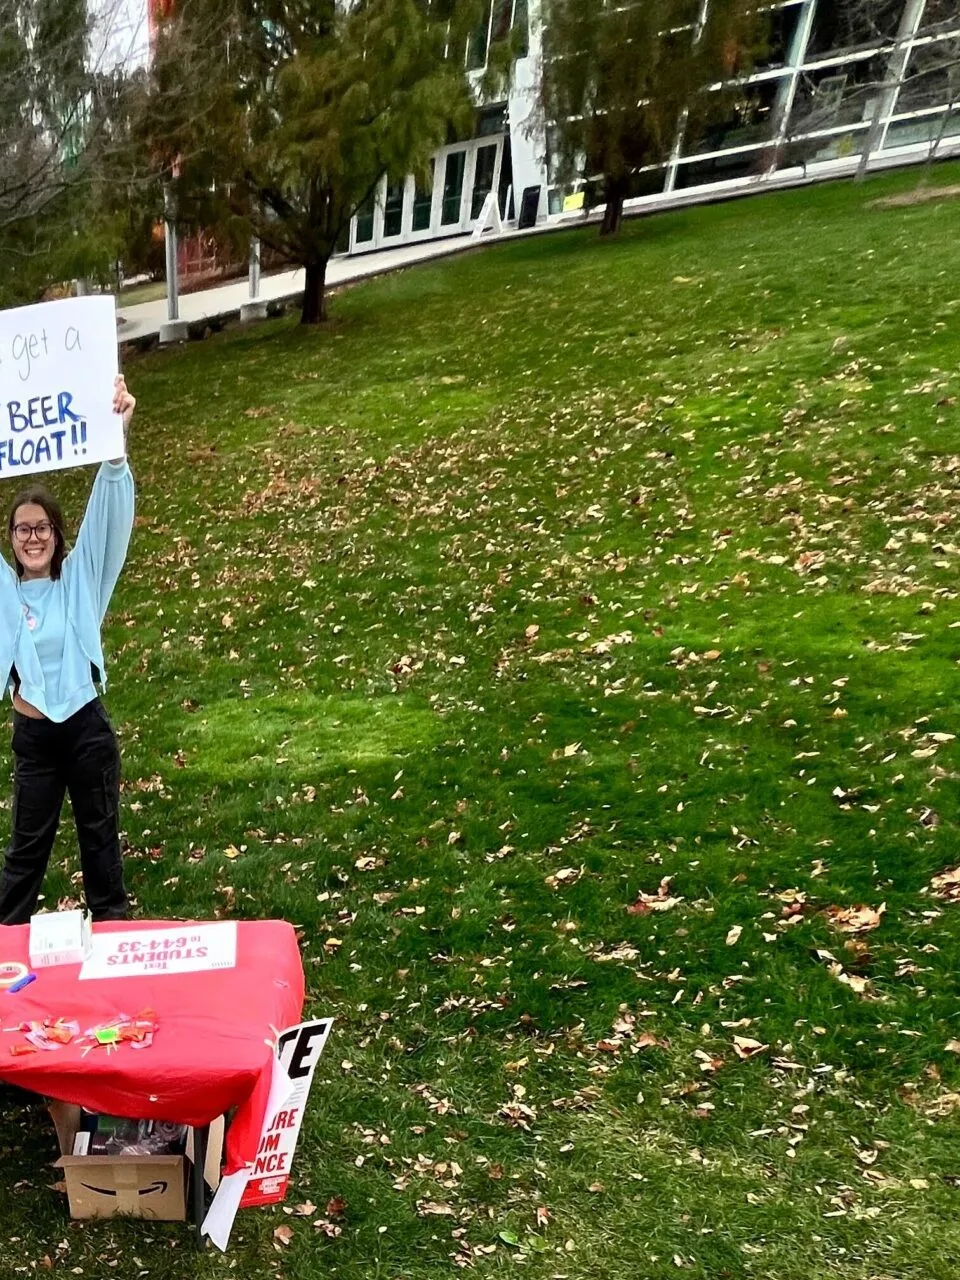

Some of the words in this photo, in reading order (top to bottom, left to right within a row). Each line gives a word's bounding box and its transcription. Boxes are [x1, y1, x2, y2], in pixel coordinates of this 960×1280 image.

[12, 328, 48, 381] get
[65, 326, 82, 351] a
[7, 391, 86, 432] BEER
[107, 947, 209, 965] STUDENTS
[118, 937, 187, 953] 644-33
[250, 1152, 288, 1175] NCE
